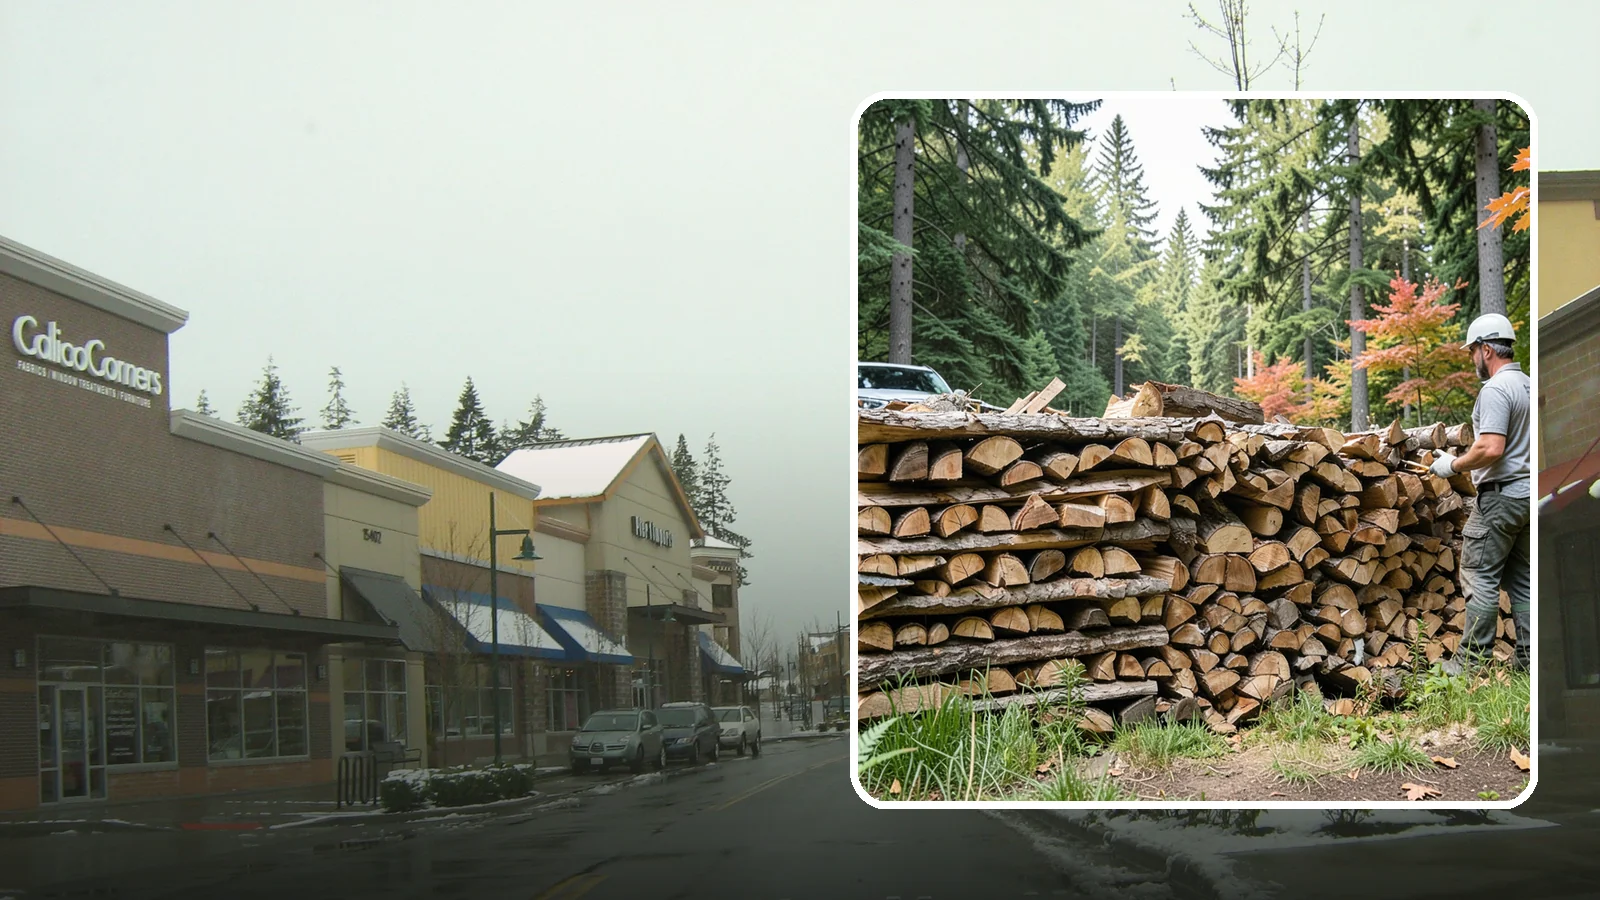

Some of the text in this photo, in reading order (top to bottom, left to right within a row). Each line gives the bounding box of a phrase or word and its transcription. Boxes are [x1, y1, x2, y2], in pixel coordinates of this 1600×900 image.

[16, 360, 151, 408] FABRICS WINDOW TREATMENTS FURNITURE
